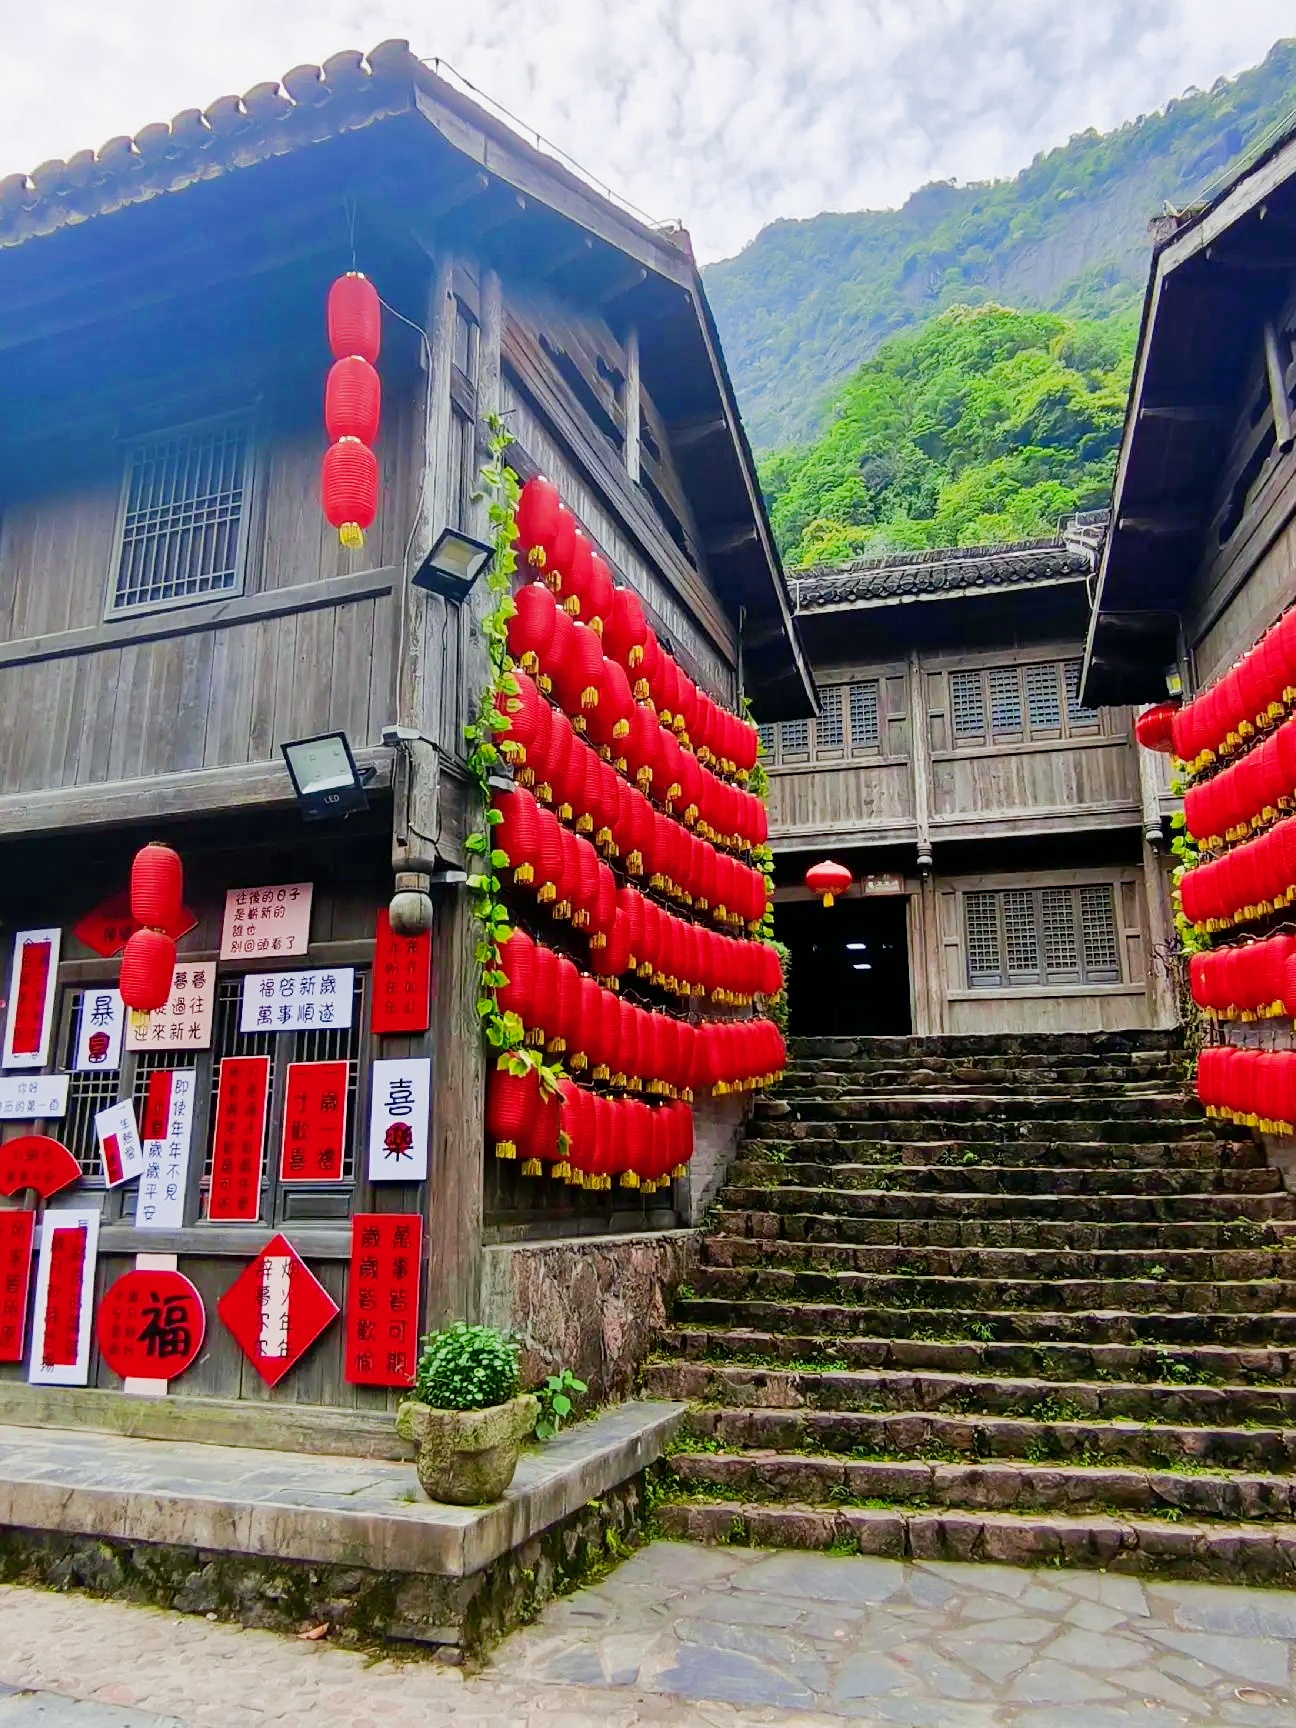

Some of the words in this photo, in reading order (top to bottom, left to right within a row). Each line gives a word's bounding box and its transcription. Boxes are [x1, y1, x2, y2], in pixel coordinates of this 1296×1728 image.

[323, 794, 340, 804] LED
[257, 1001, 335, 1026] 萬事順遂
[136, 1290, 193, 1360] 福
